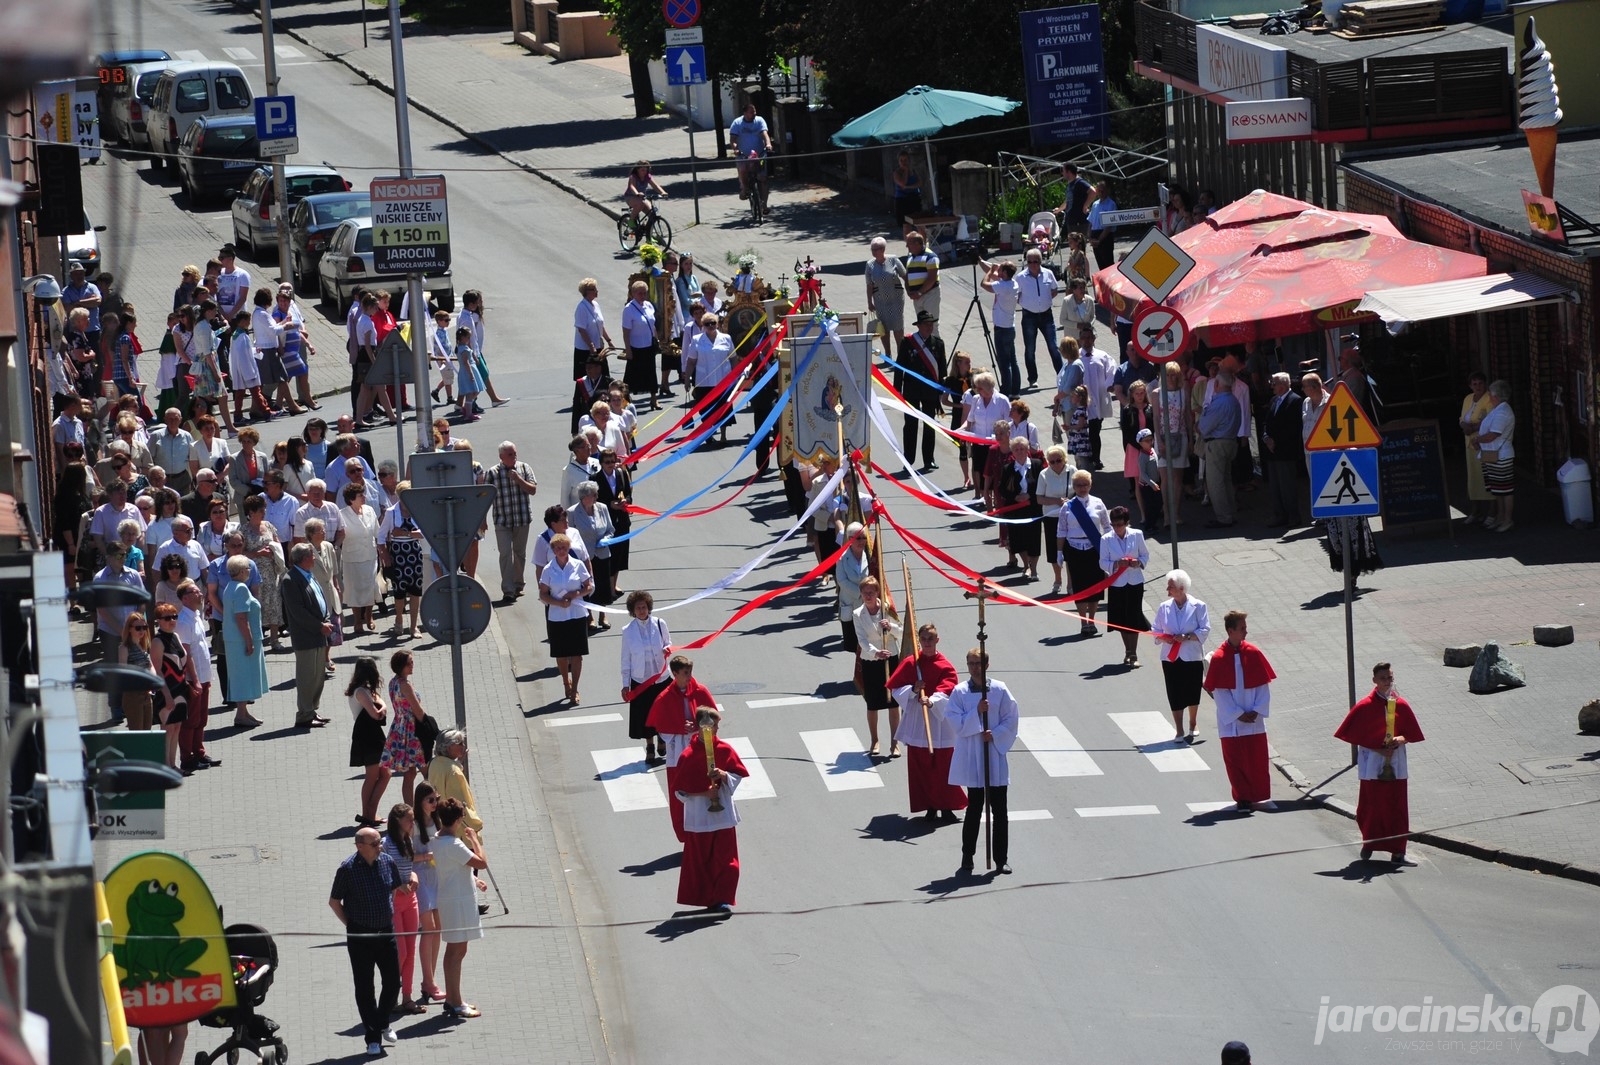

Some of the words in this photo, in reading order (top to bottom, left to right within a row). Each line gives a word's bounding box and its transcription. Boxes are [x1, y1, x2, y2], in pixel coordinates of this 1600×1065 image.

[1048, 24, 1080, 34] TEREN
[1038, 33, 1093, 46] PRYWATNY
[1208, 39, 1262, 100] ROSSMANN
[1062, 89, 1091, 97] KLIENTÓW
[1231, 112, 1308, 126] ROSSMANN
[374, 183, 441, 198] NEONET
[385, 202, 432, 213] ZAWSZE
[376, 213, 411, 224] NISKIE
[414, 212, 443, 222] CENY
[1118, 212, 1145, 221] Wolności
[393, 228, 422, 242] 150
[427, 230, 441, 241] m
[387, 248, 436, 260] JAROCIN
[389, 261, 436, 269] WROCŁAWSKA
[98, 815, 127, 827] OK
[118, 828, 158, 837] Wyszyńskiego
[122, 979, 222, 1008] abka
